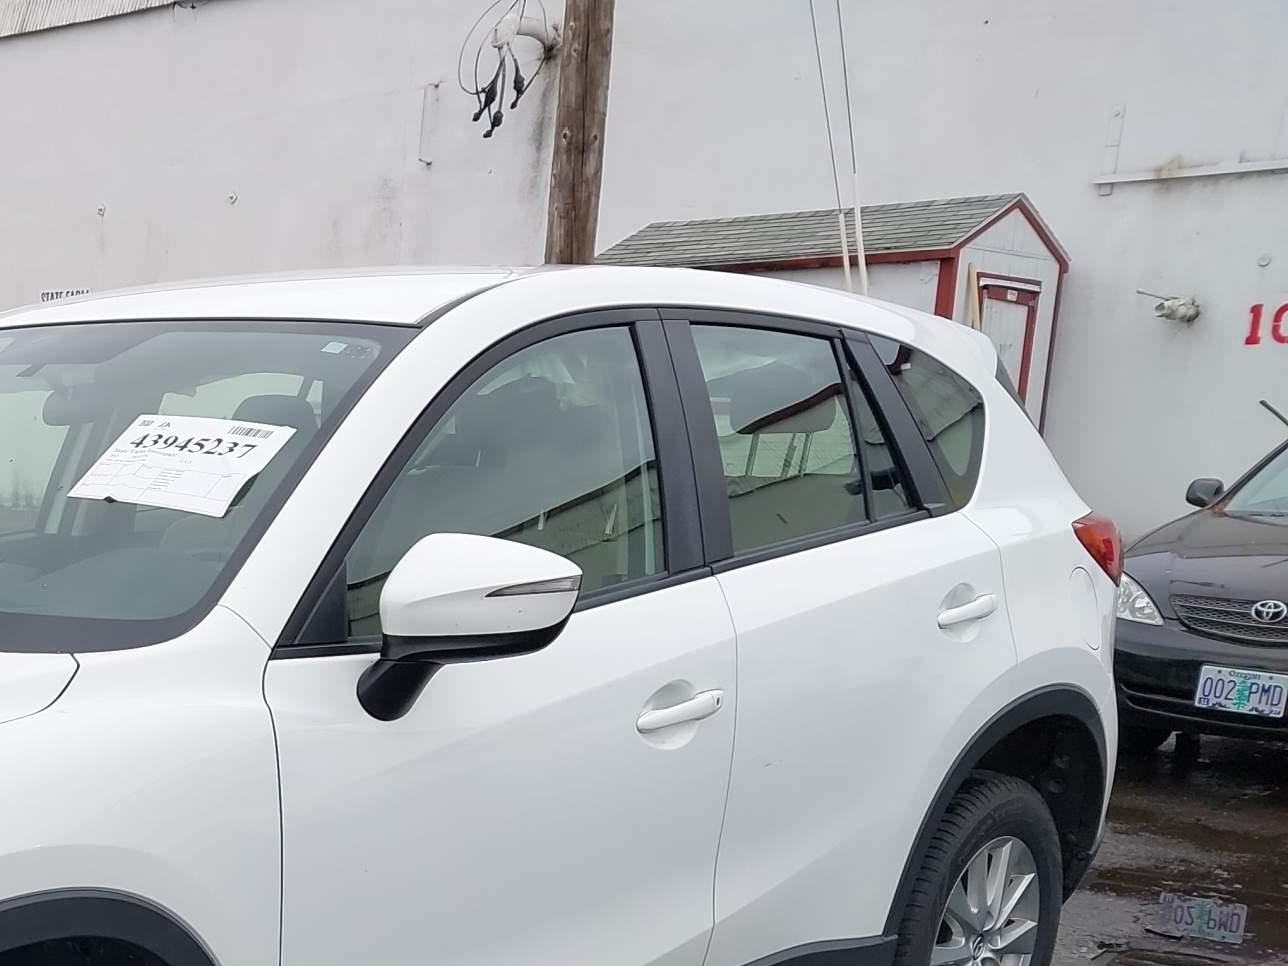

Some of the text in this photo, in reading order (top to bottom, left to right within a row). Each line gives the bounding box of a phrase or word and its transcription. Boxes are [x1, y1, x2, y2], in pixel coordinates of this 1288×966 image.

[129, 433, 258, 459] 43945237
[1202, 676, 1284, 707] 002 PMD
